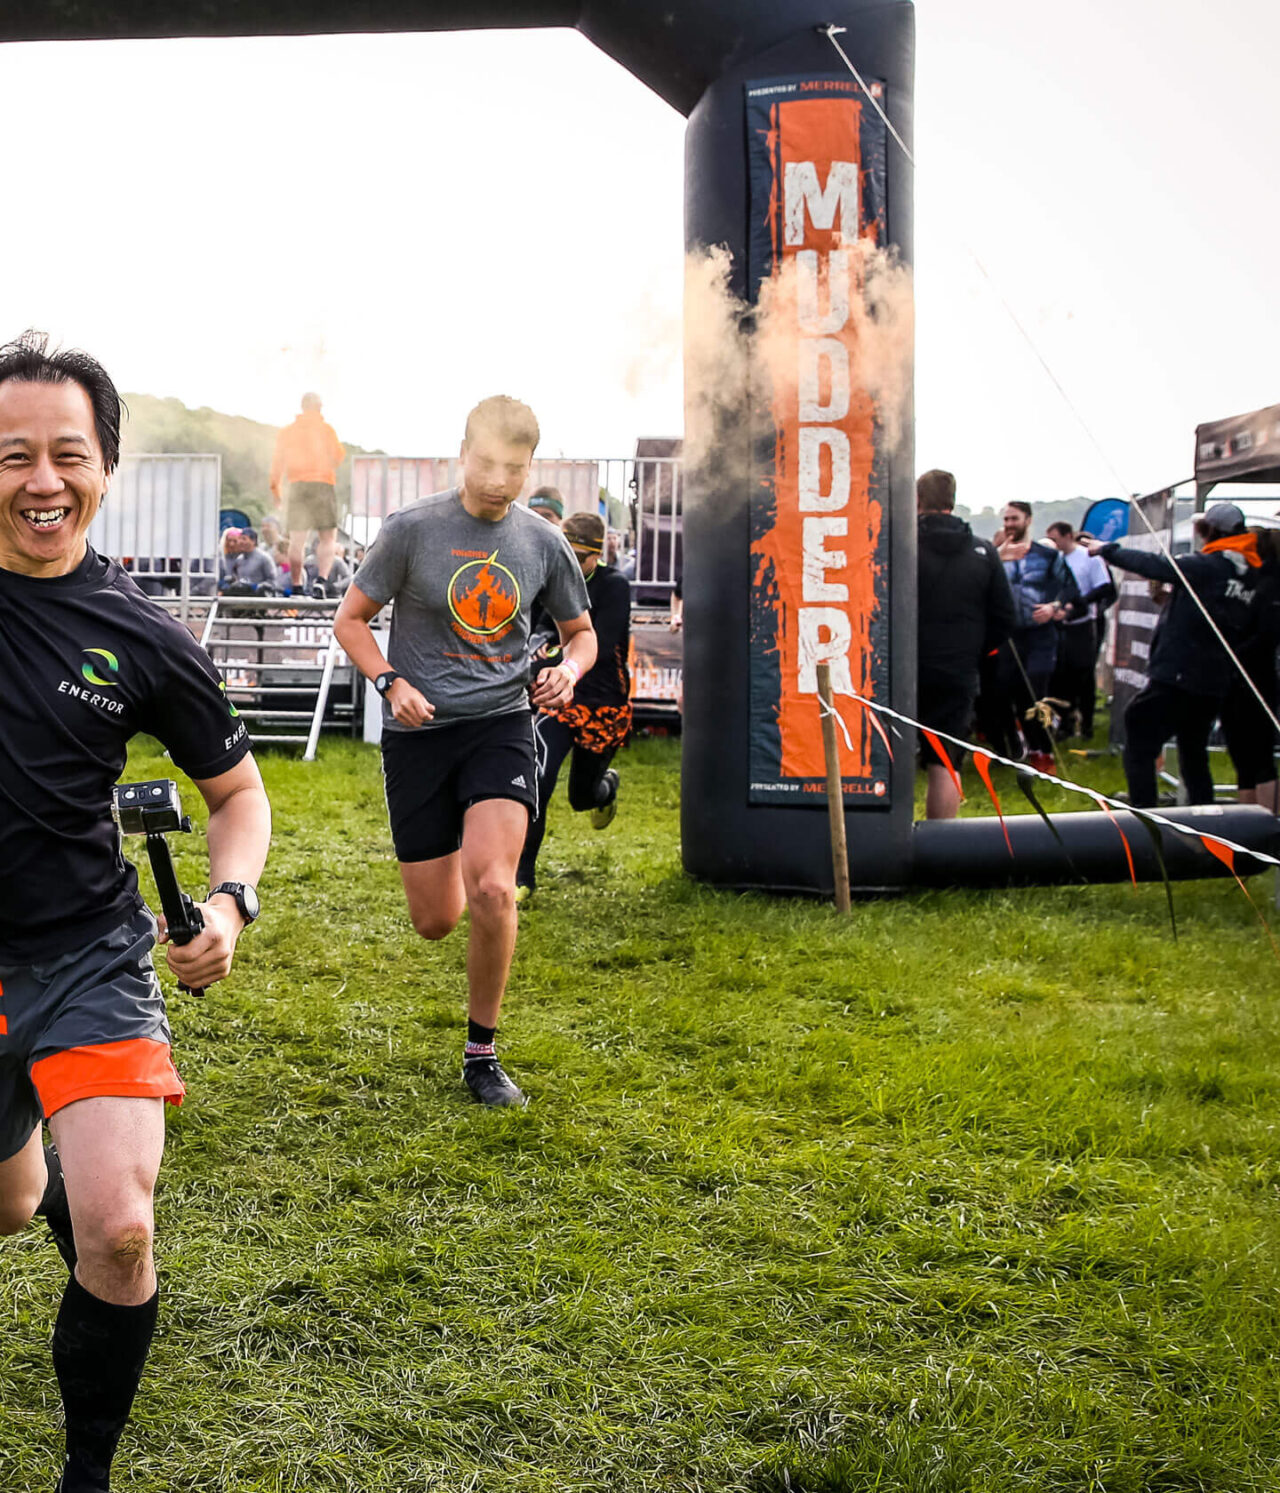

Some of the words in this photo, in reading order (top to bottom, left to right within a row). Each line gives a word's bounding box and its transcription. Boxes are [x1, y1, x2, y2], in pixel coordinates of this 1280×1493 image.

[784, 161, 858, 694] MUDDER
[58, 680, 124, 715] ENERTOR
[224, 720, 248, 751] ENER
[802, 783, 872, 794] MERELL
